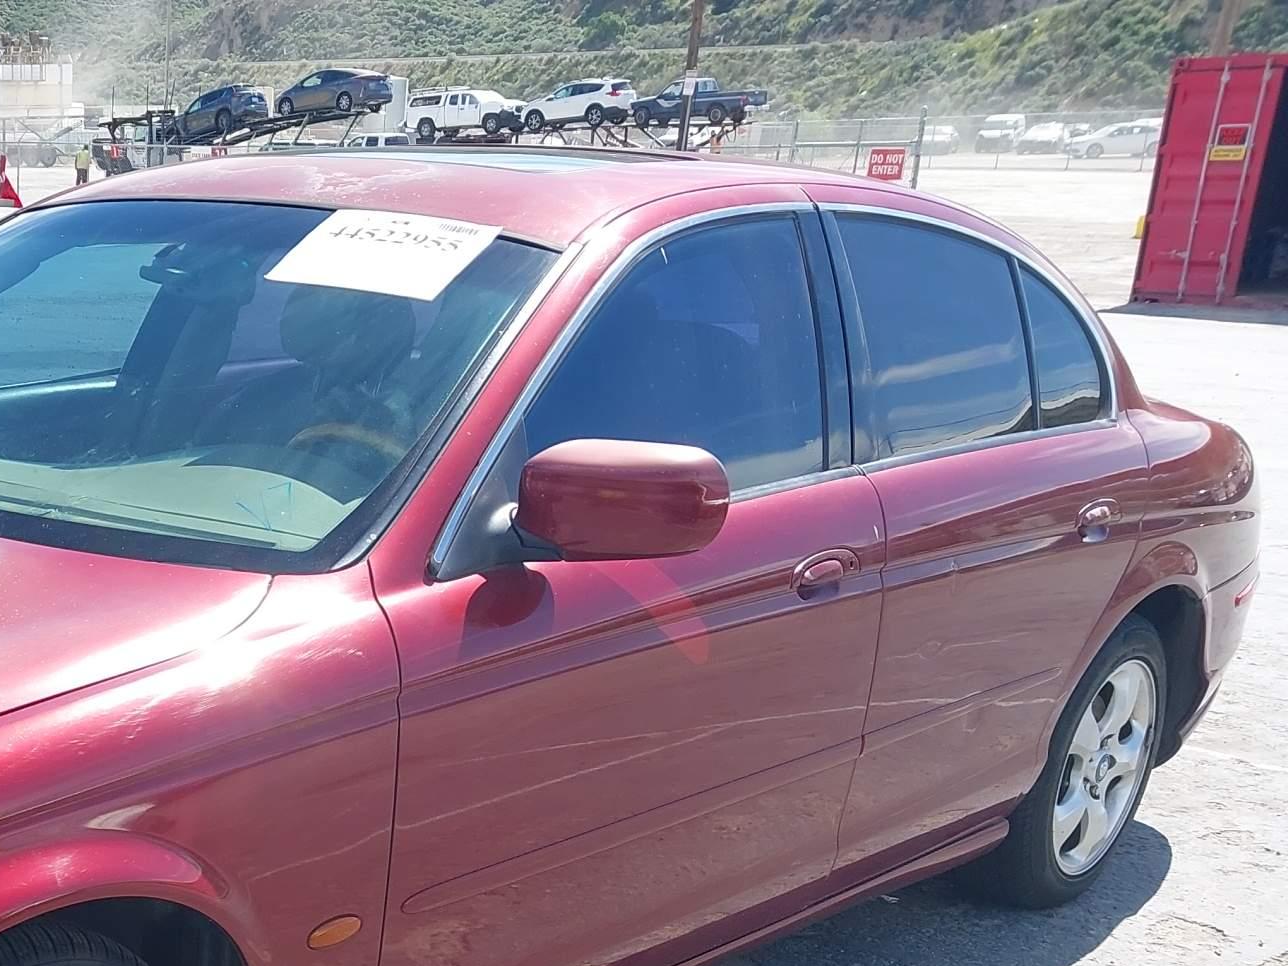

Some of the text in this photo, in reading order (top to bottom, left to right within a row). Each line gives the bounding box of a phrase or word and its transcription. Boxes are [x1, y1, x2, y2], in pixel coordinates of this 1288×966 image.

[871, 153, 904, 165] DO NOT
[872, 164, 899, 175] ENTER
[328, 225, 463, 252] 44522955
